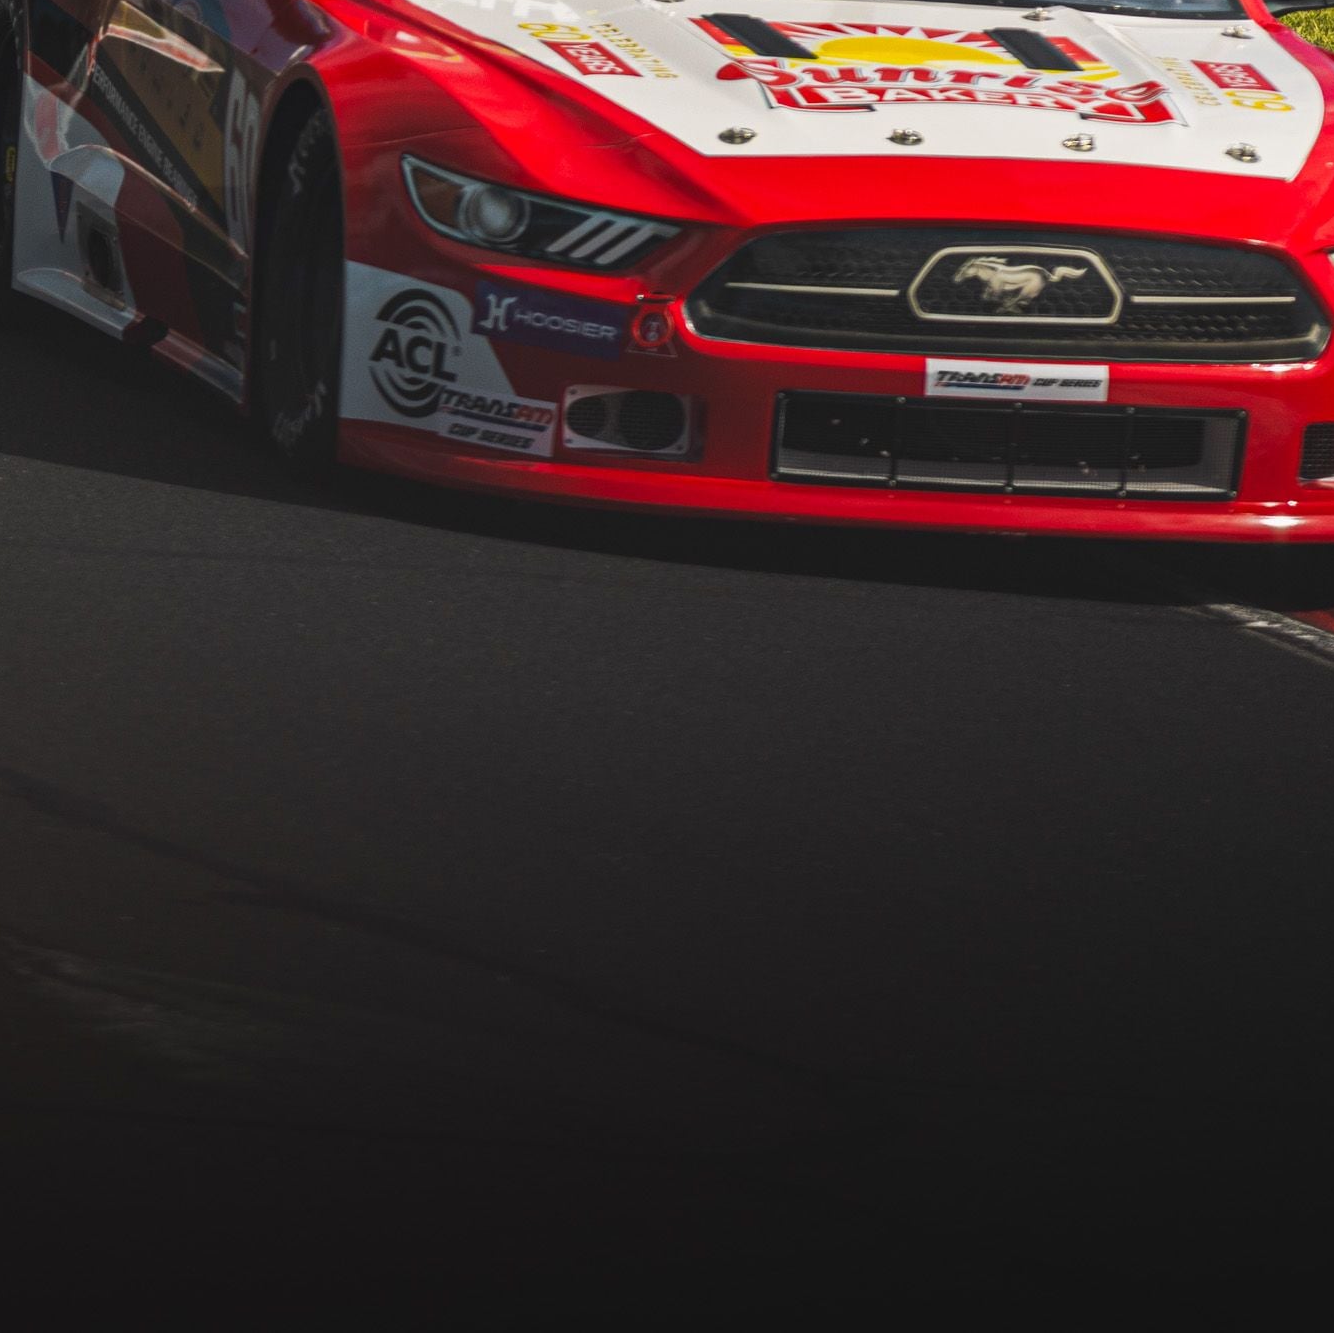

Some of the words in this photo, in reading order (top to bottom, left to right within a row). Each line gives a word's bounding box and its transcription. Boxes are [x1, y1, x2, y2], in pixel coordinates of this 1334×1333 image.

[517, 21, 592, 41] 60
[561, 44, 624, 75] YEARS
[716, 57, 1164, 103] Sunrise
[817, 86, 1111, 112] BAKERY
[516, 309, 618, 341] HOOSIER
[370, 327, 457, 382] ACL
